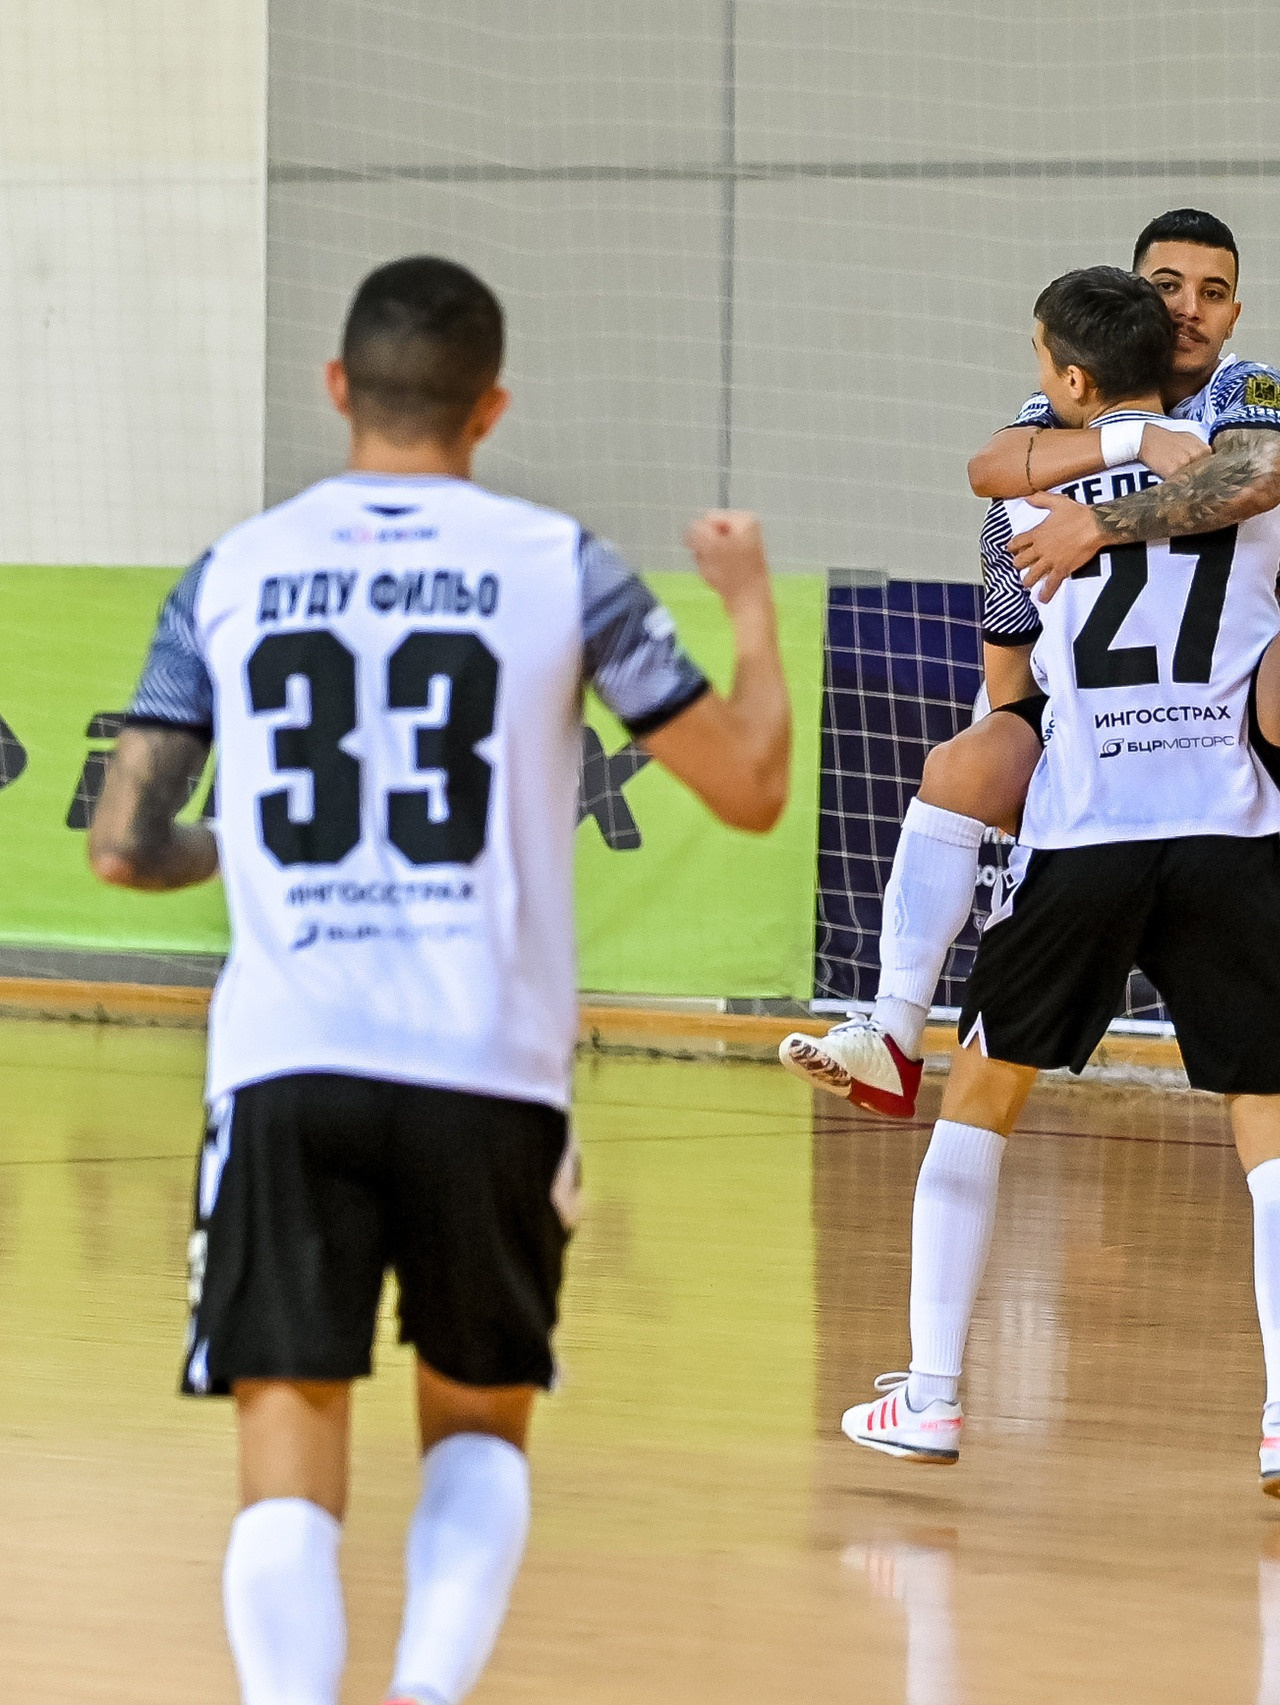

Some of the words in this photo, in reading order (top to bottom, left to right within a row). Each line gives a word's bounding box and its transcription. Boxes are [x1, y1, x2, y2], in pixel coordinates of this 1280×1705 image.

[259, 570, 358, 625] ДУДУ
[369, 569, 500, 618] ФИЛЬО
[1074, 523, 1239, 689] 27
[246, 629, 501, 868] 33
[1095, 705, 1231, 729] ИНГОССТРАХ
